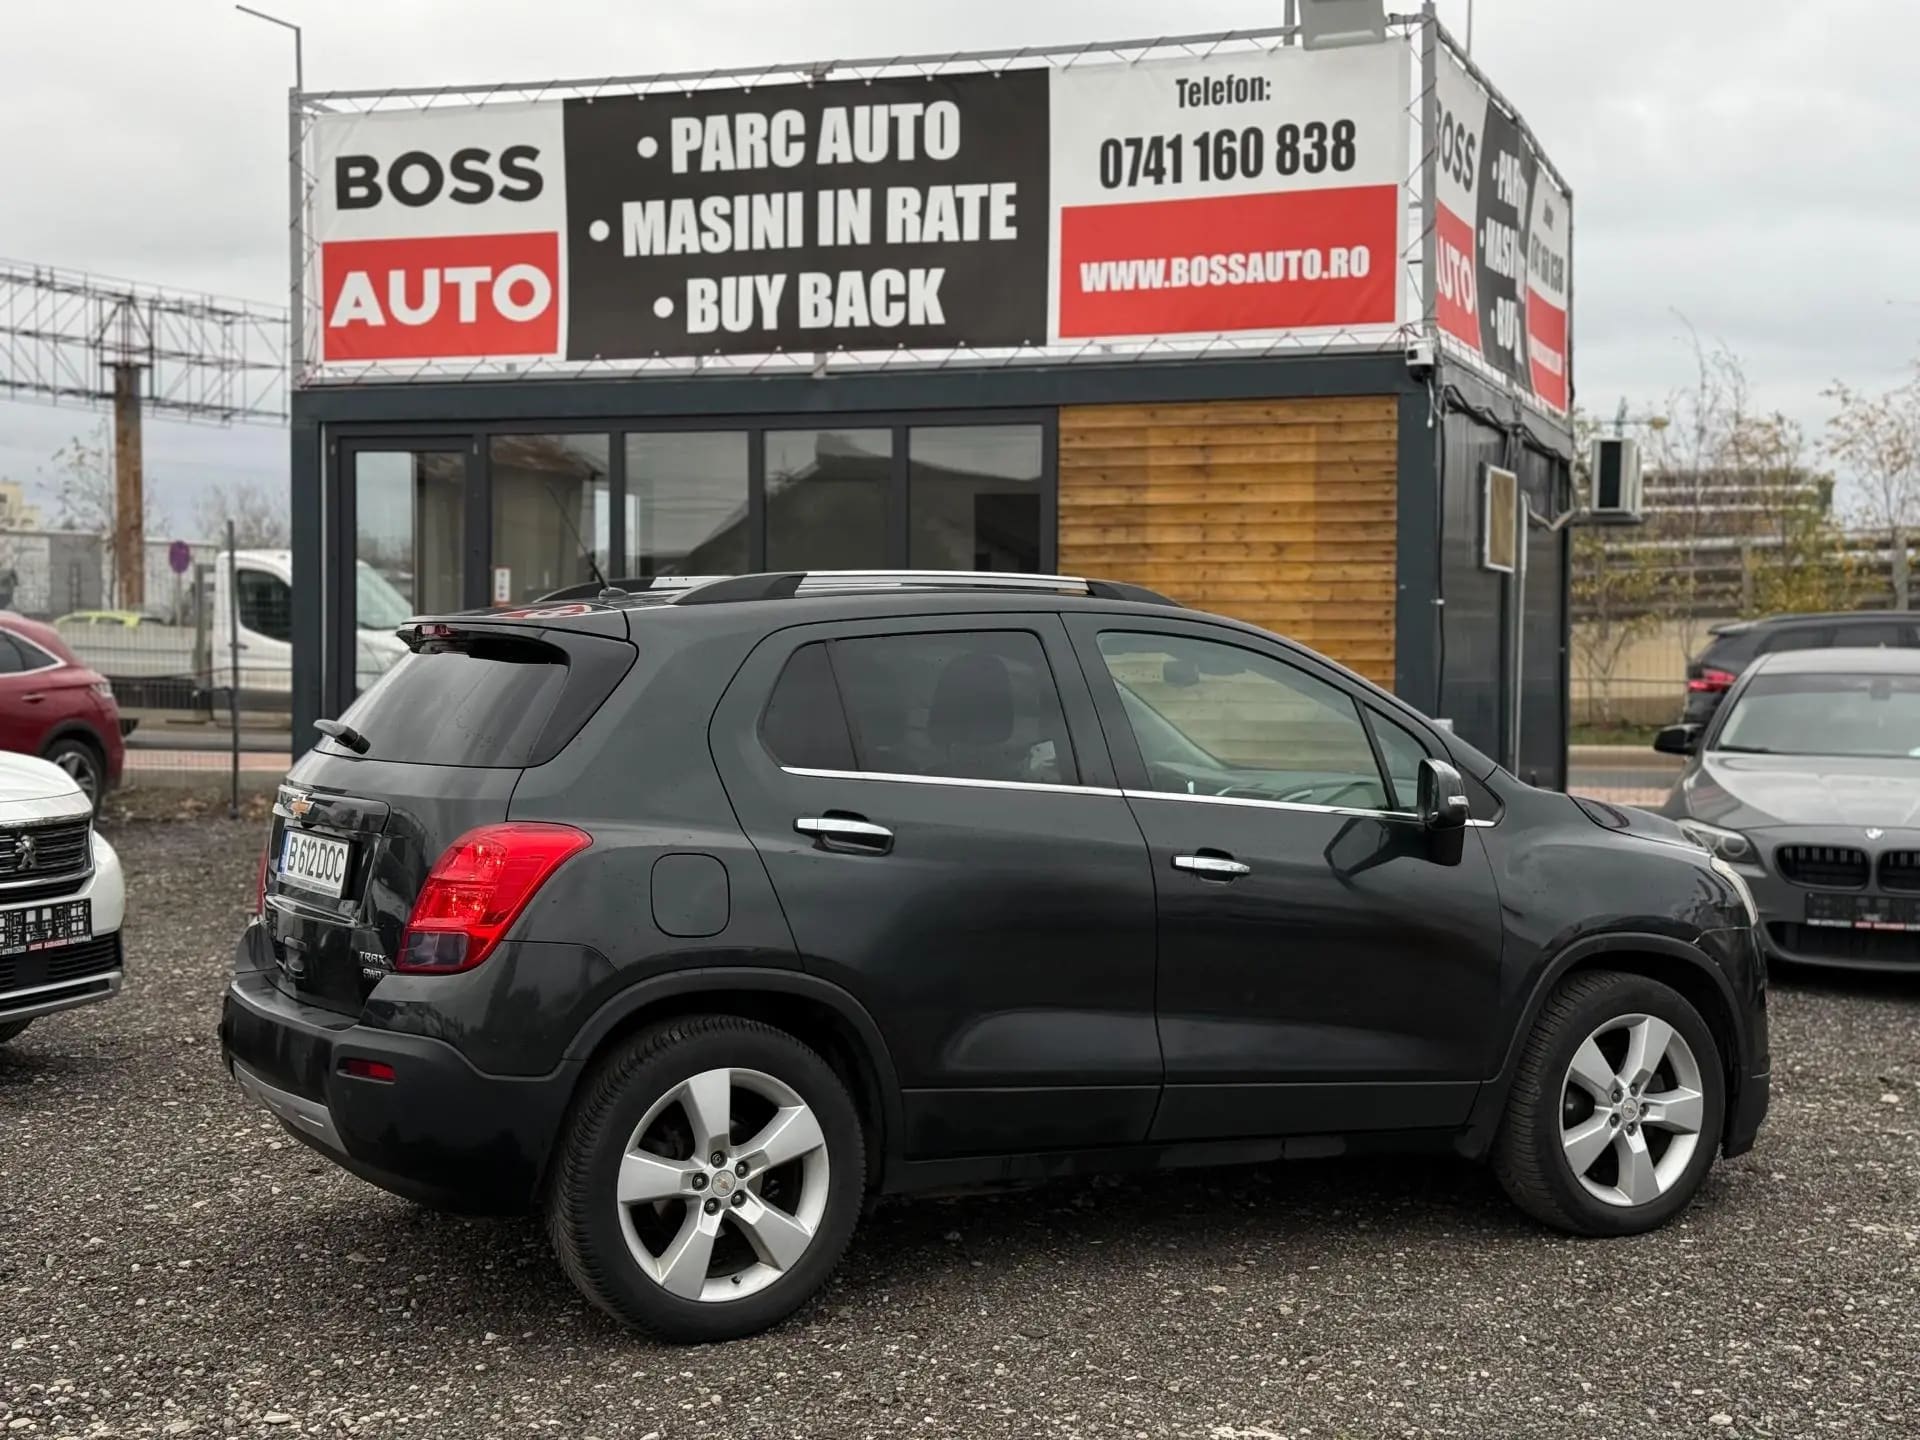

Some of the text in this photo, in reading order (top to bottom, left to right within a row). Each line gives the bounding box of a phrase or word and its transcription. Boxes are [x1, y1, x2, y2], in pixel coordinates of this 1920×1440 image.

[1175, 74, 1271, 108] Telefon:
[671, 100, 960, 174] PARC AUTO
[1099, 119, 1356, 190] 0741 160 838
[335, 144, 544, 211] BOSS
[622, 182, 1017, 257] MASINI IN RATE
[329, 263, 552, 328] AUTO
[686, 267, 946, 334] BUY BACK
[1079, 245, 1370, 293] WWW.BOSSAUTO.RO
[289, 836, 299, 872] B
[298, 839, 318, 877] 612
[316, 843, 345, 884] DOC
[359, 950, 386, 965] TRAX
